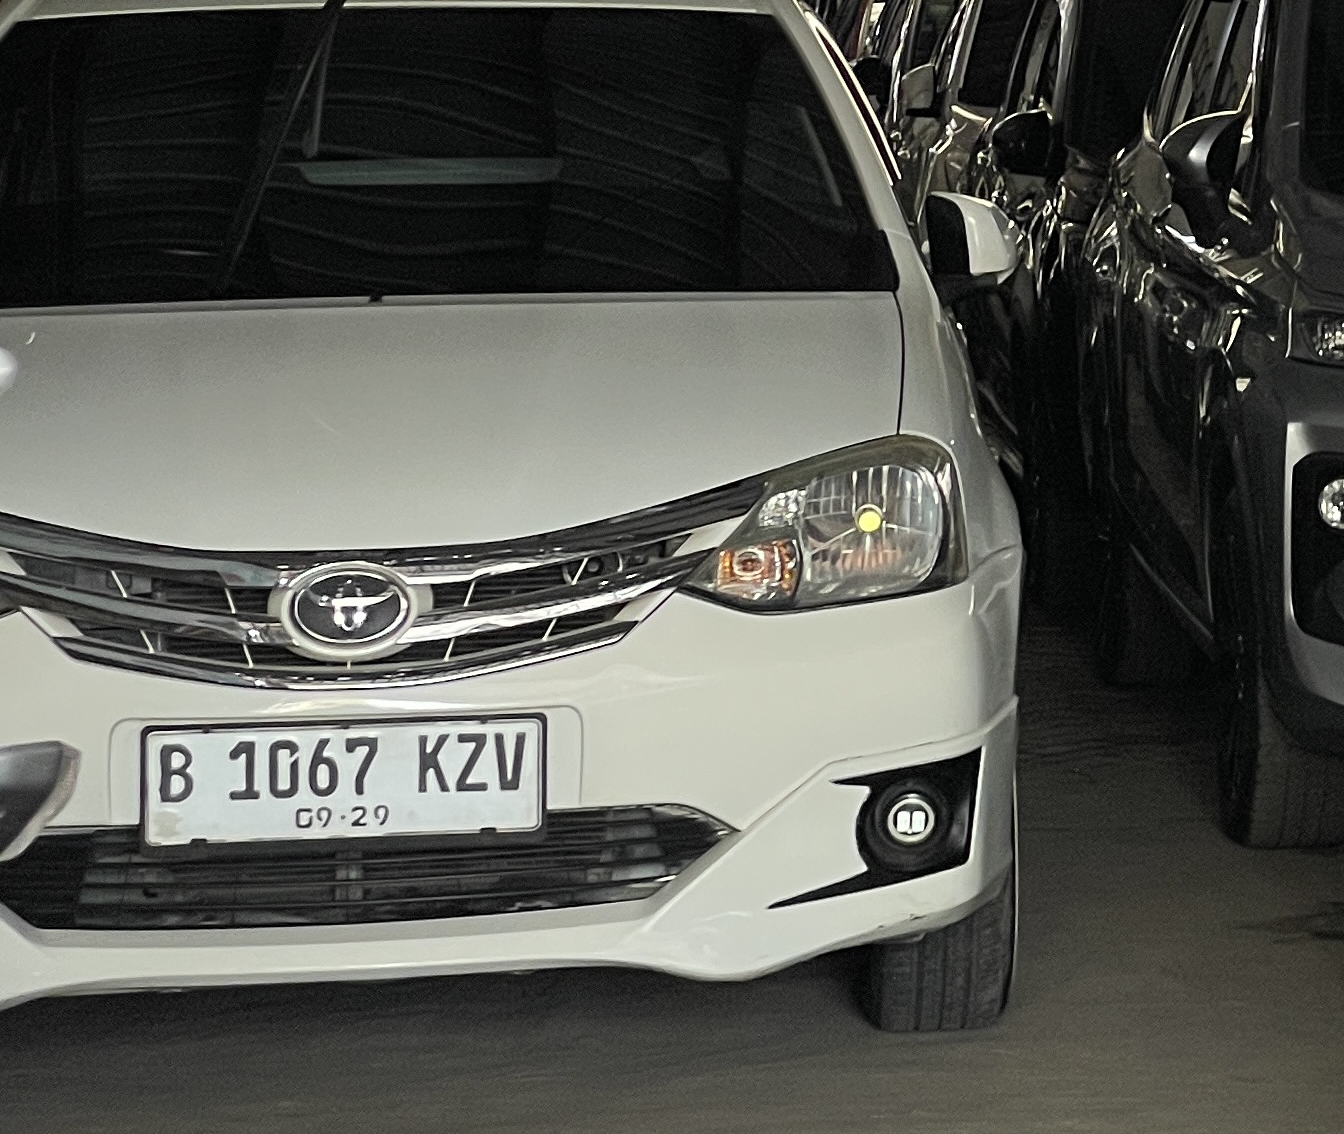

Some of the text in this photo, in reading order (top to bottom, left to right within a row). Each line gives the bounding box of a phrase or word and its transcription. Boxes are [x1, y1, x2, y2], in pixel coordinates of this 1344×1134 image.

[159, 732, 526, 803] B 1067 KZV
